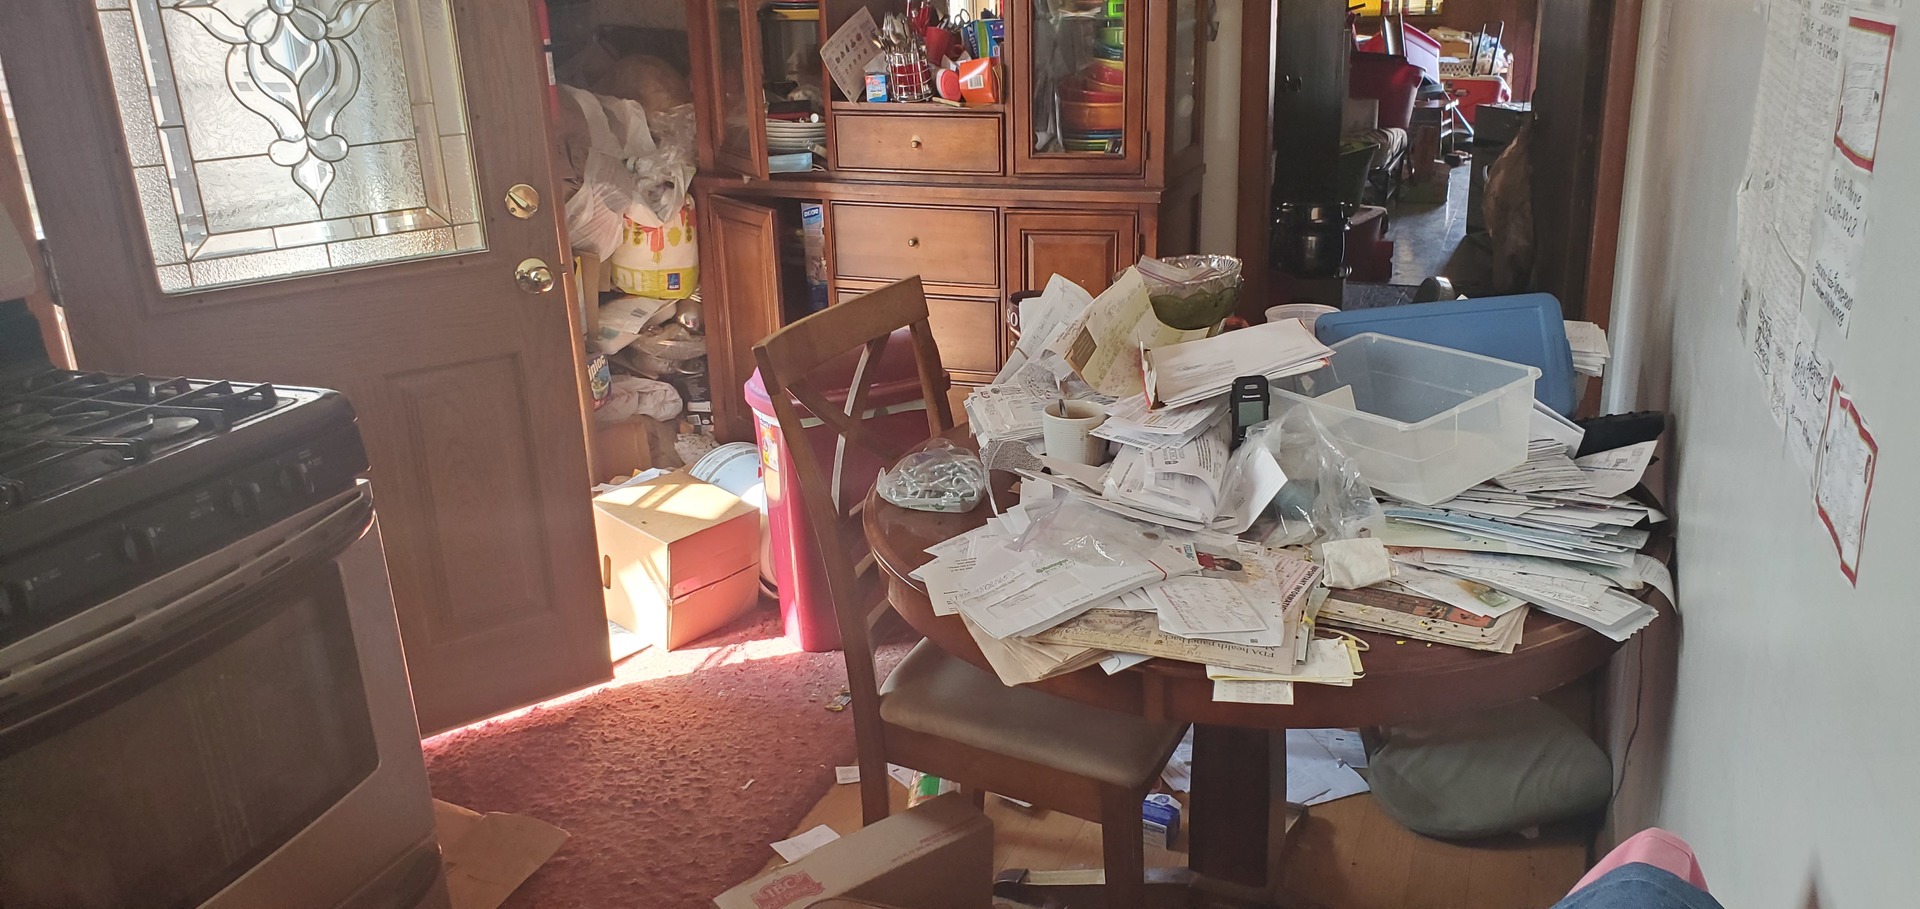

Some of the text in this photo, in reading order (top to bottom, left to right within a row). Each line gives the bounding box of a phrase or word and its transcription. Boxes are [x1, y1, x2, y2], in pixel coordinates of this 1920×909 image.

[587, 354, 606, 381] iploc
[1281, 564, 1320, 613] IMPORTANT INFORMATIO
[1217, 642, 1249, 654] health
[1252, 649, 1274, 658] FDA
